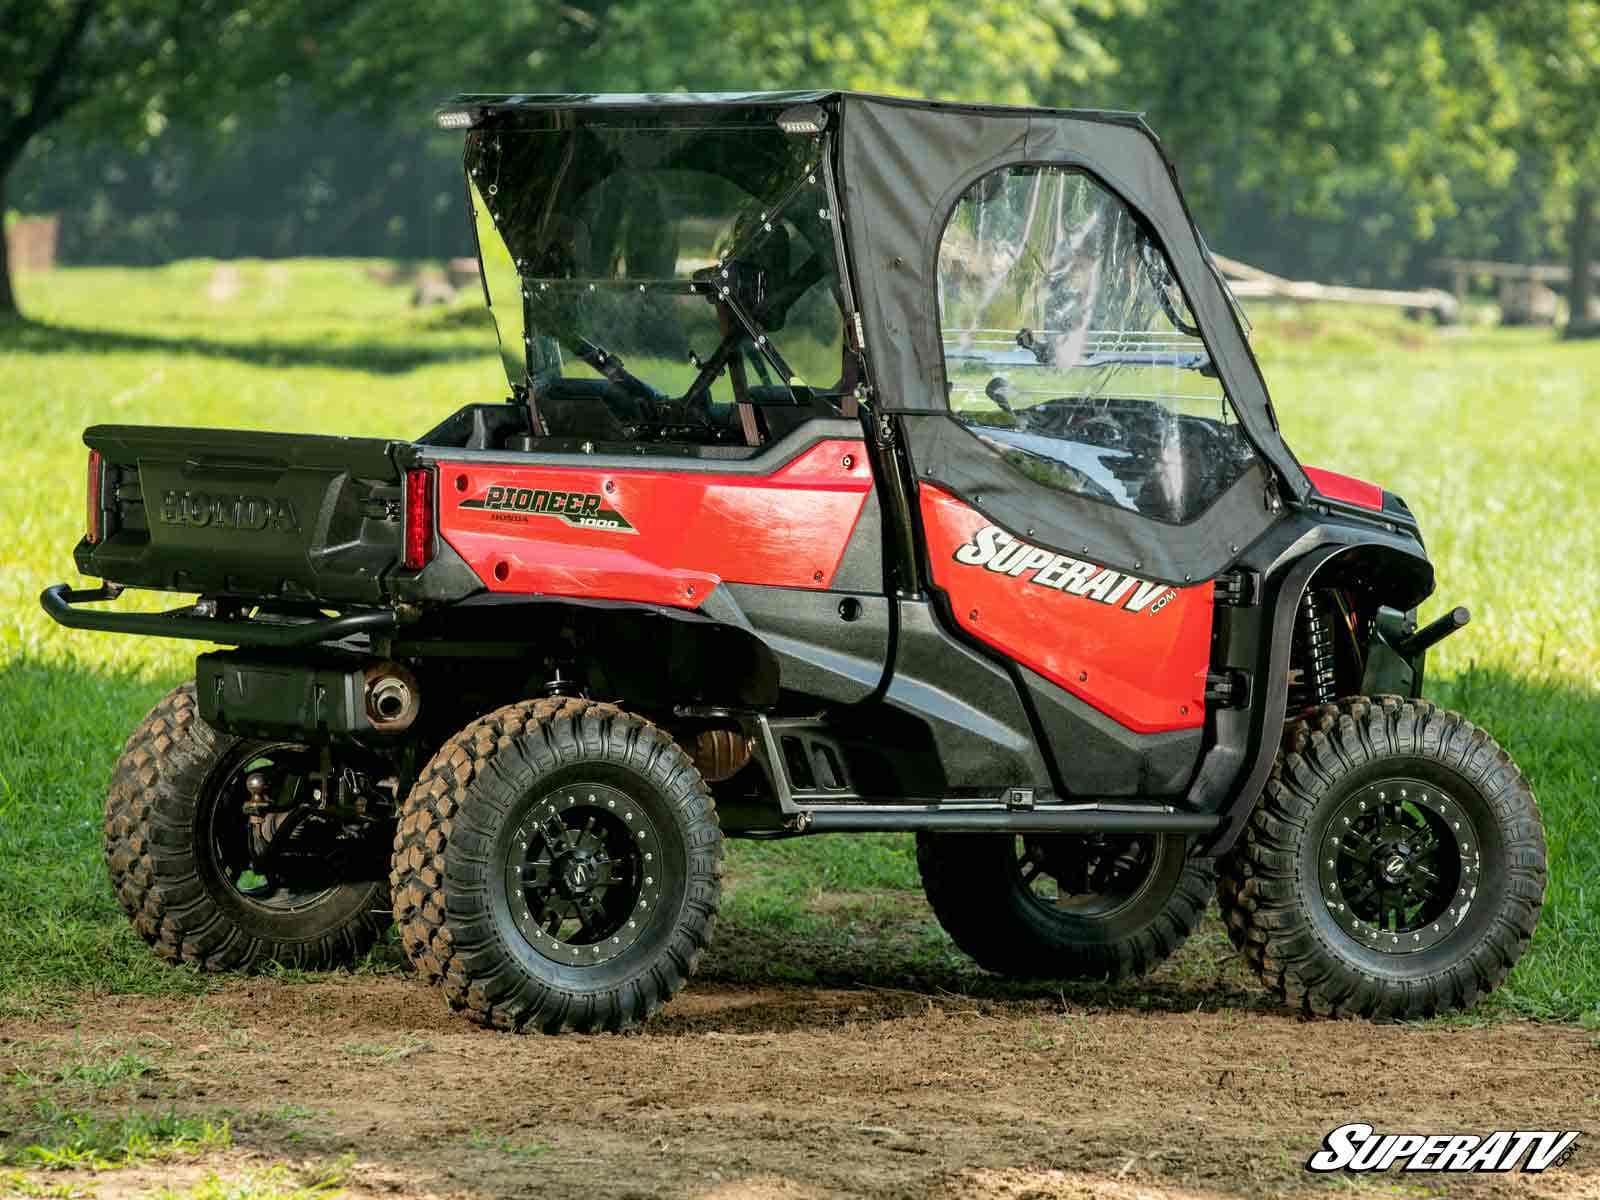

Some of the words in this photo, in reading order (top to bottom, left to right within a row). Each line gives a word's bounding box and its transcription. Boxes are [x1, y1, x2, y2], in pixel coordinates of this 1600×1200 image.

[160, 487, 303, 533] HONDA
[485, 485, 603, 517] PIONEER
[578, 517, 619, 529] 1000
